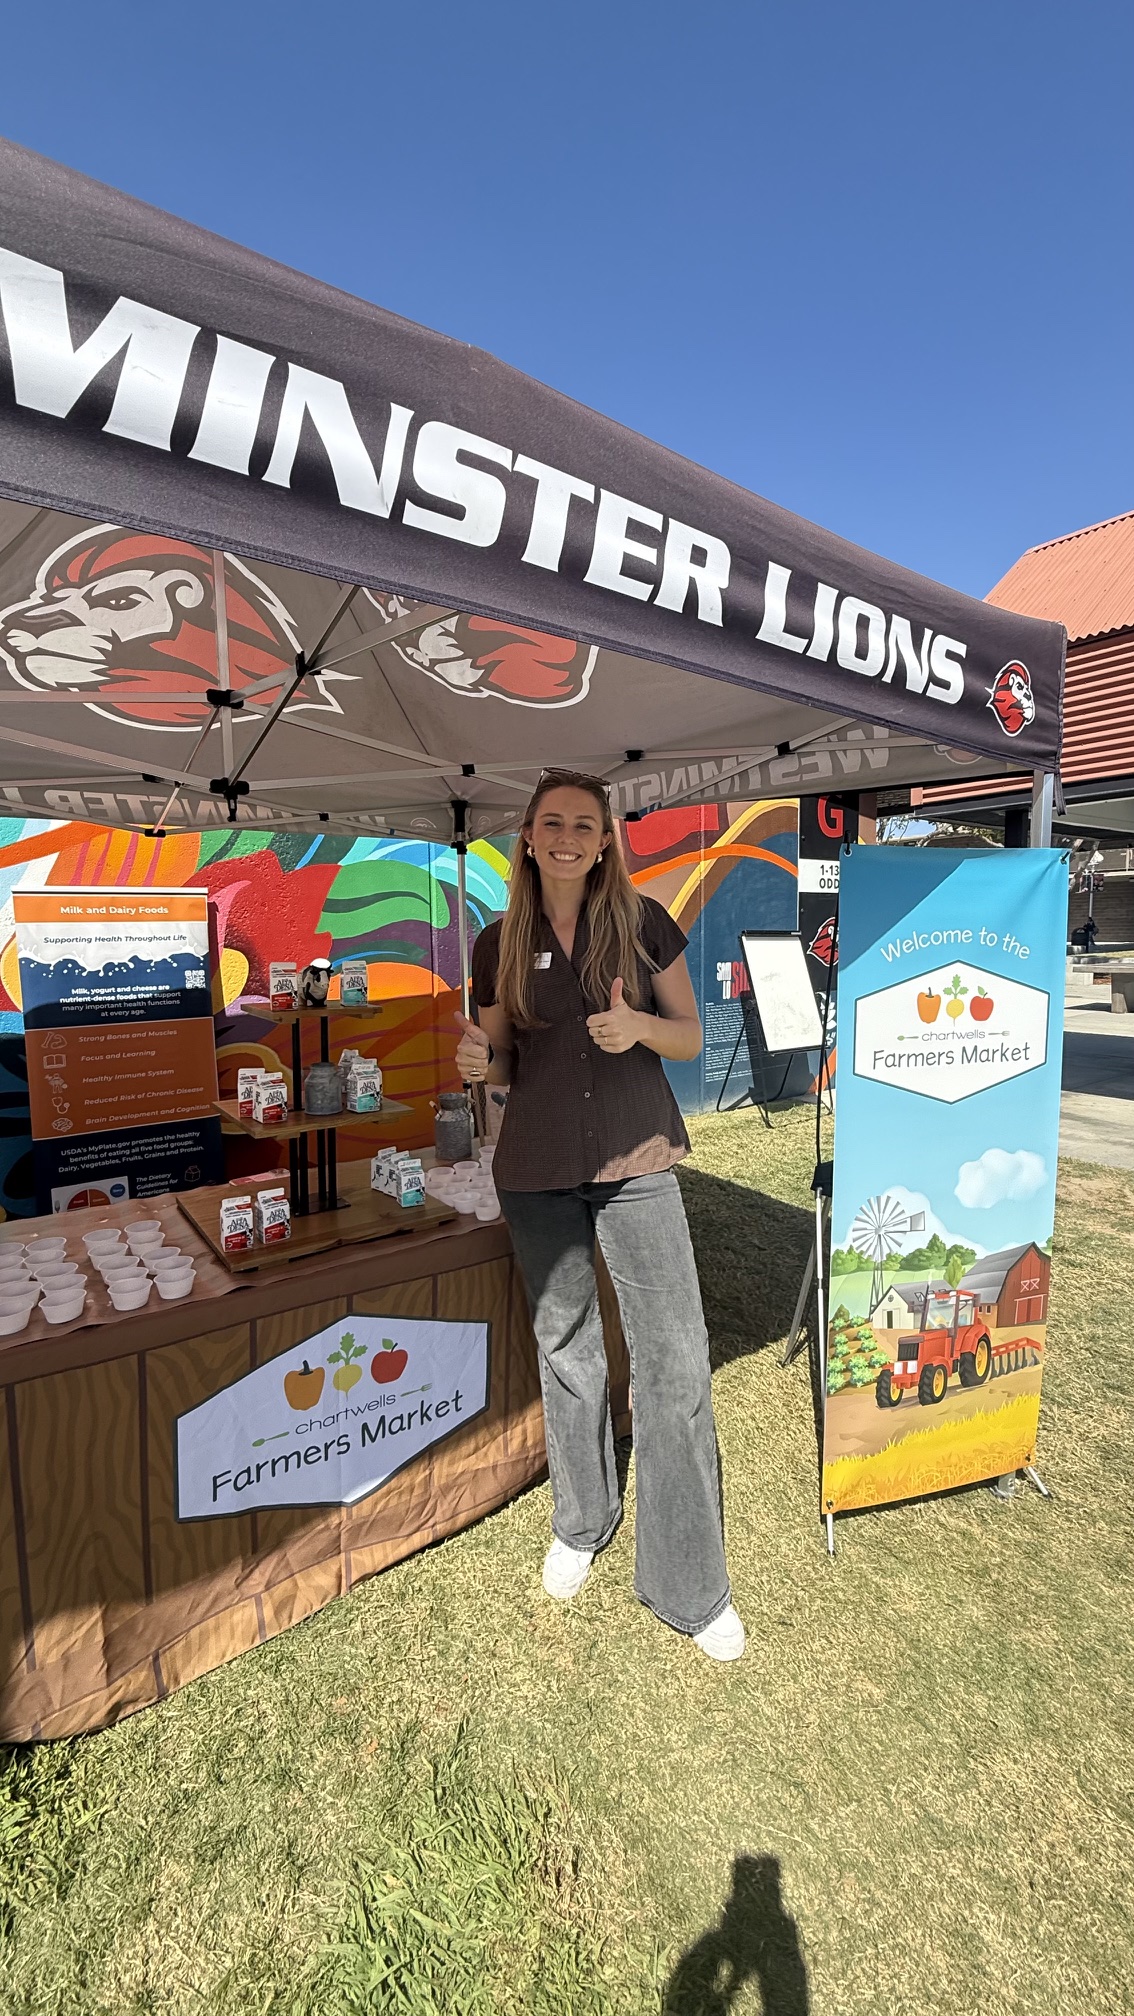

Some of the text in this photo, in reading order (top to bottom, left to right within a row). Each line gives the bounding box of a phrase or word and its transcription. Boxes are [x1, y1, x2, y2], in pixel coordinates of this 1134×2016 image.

[755, 560, 968, 705] LIONS
[817, 795, 844, 838] G
[60, 906, 84, 914] Milk
[86, 906, 106, 914] and
[109, 906, 136, 916] Dairy
[44, 936, 92, 944] Supporting
[124, 934, 171, 942] Throughout
[880, 926, 1030, 963] Welcome to the
[60, 995, 116, 1004] nutrient-dense
[71, 988, 90, 996] Milk,
[90, 986, 116, 995] yogurt
[85, 1002, 122, 1010] important
[78, 1035, 105, 1043] Strong
[922, 1029, 986, 1042] chartwells
[122, 1050, 156, 1058] Learning
[872, 1042, 1031, 1070] Farmers Market
[82, 1068, 175, 1084] Healthy Immune System
[84, 1096, 118, 1106] Reduced
[146, 1089, 175, 1098] Chronic
[176, 1086, 204, 1094] Disease
[86, 1116, 107, 1125] Brain
[109, 1109, 159, 1122] Development
[176, 1104, 210, 1113] Cognition
[88, 1140, 130, 1152] MyPlate.gov
[131, 1136, 163, 1146] promotes
[176, 1131, 201, 1140] healthy
[58, 1165, 80, 1174] Dairy,
[80, 1158, 121, 1169] Vegetables,
[144, 1151, 165, 1160] Grains
[70, 1154, 98, 1163] benefits
[108, 1148, 130, 1158] eating
[153, 1142, 169, 1150] food
[295, 1393, 396, 1436] chartwells
[211, 1389, 464, 1502] Farmers Market
